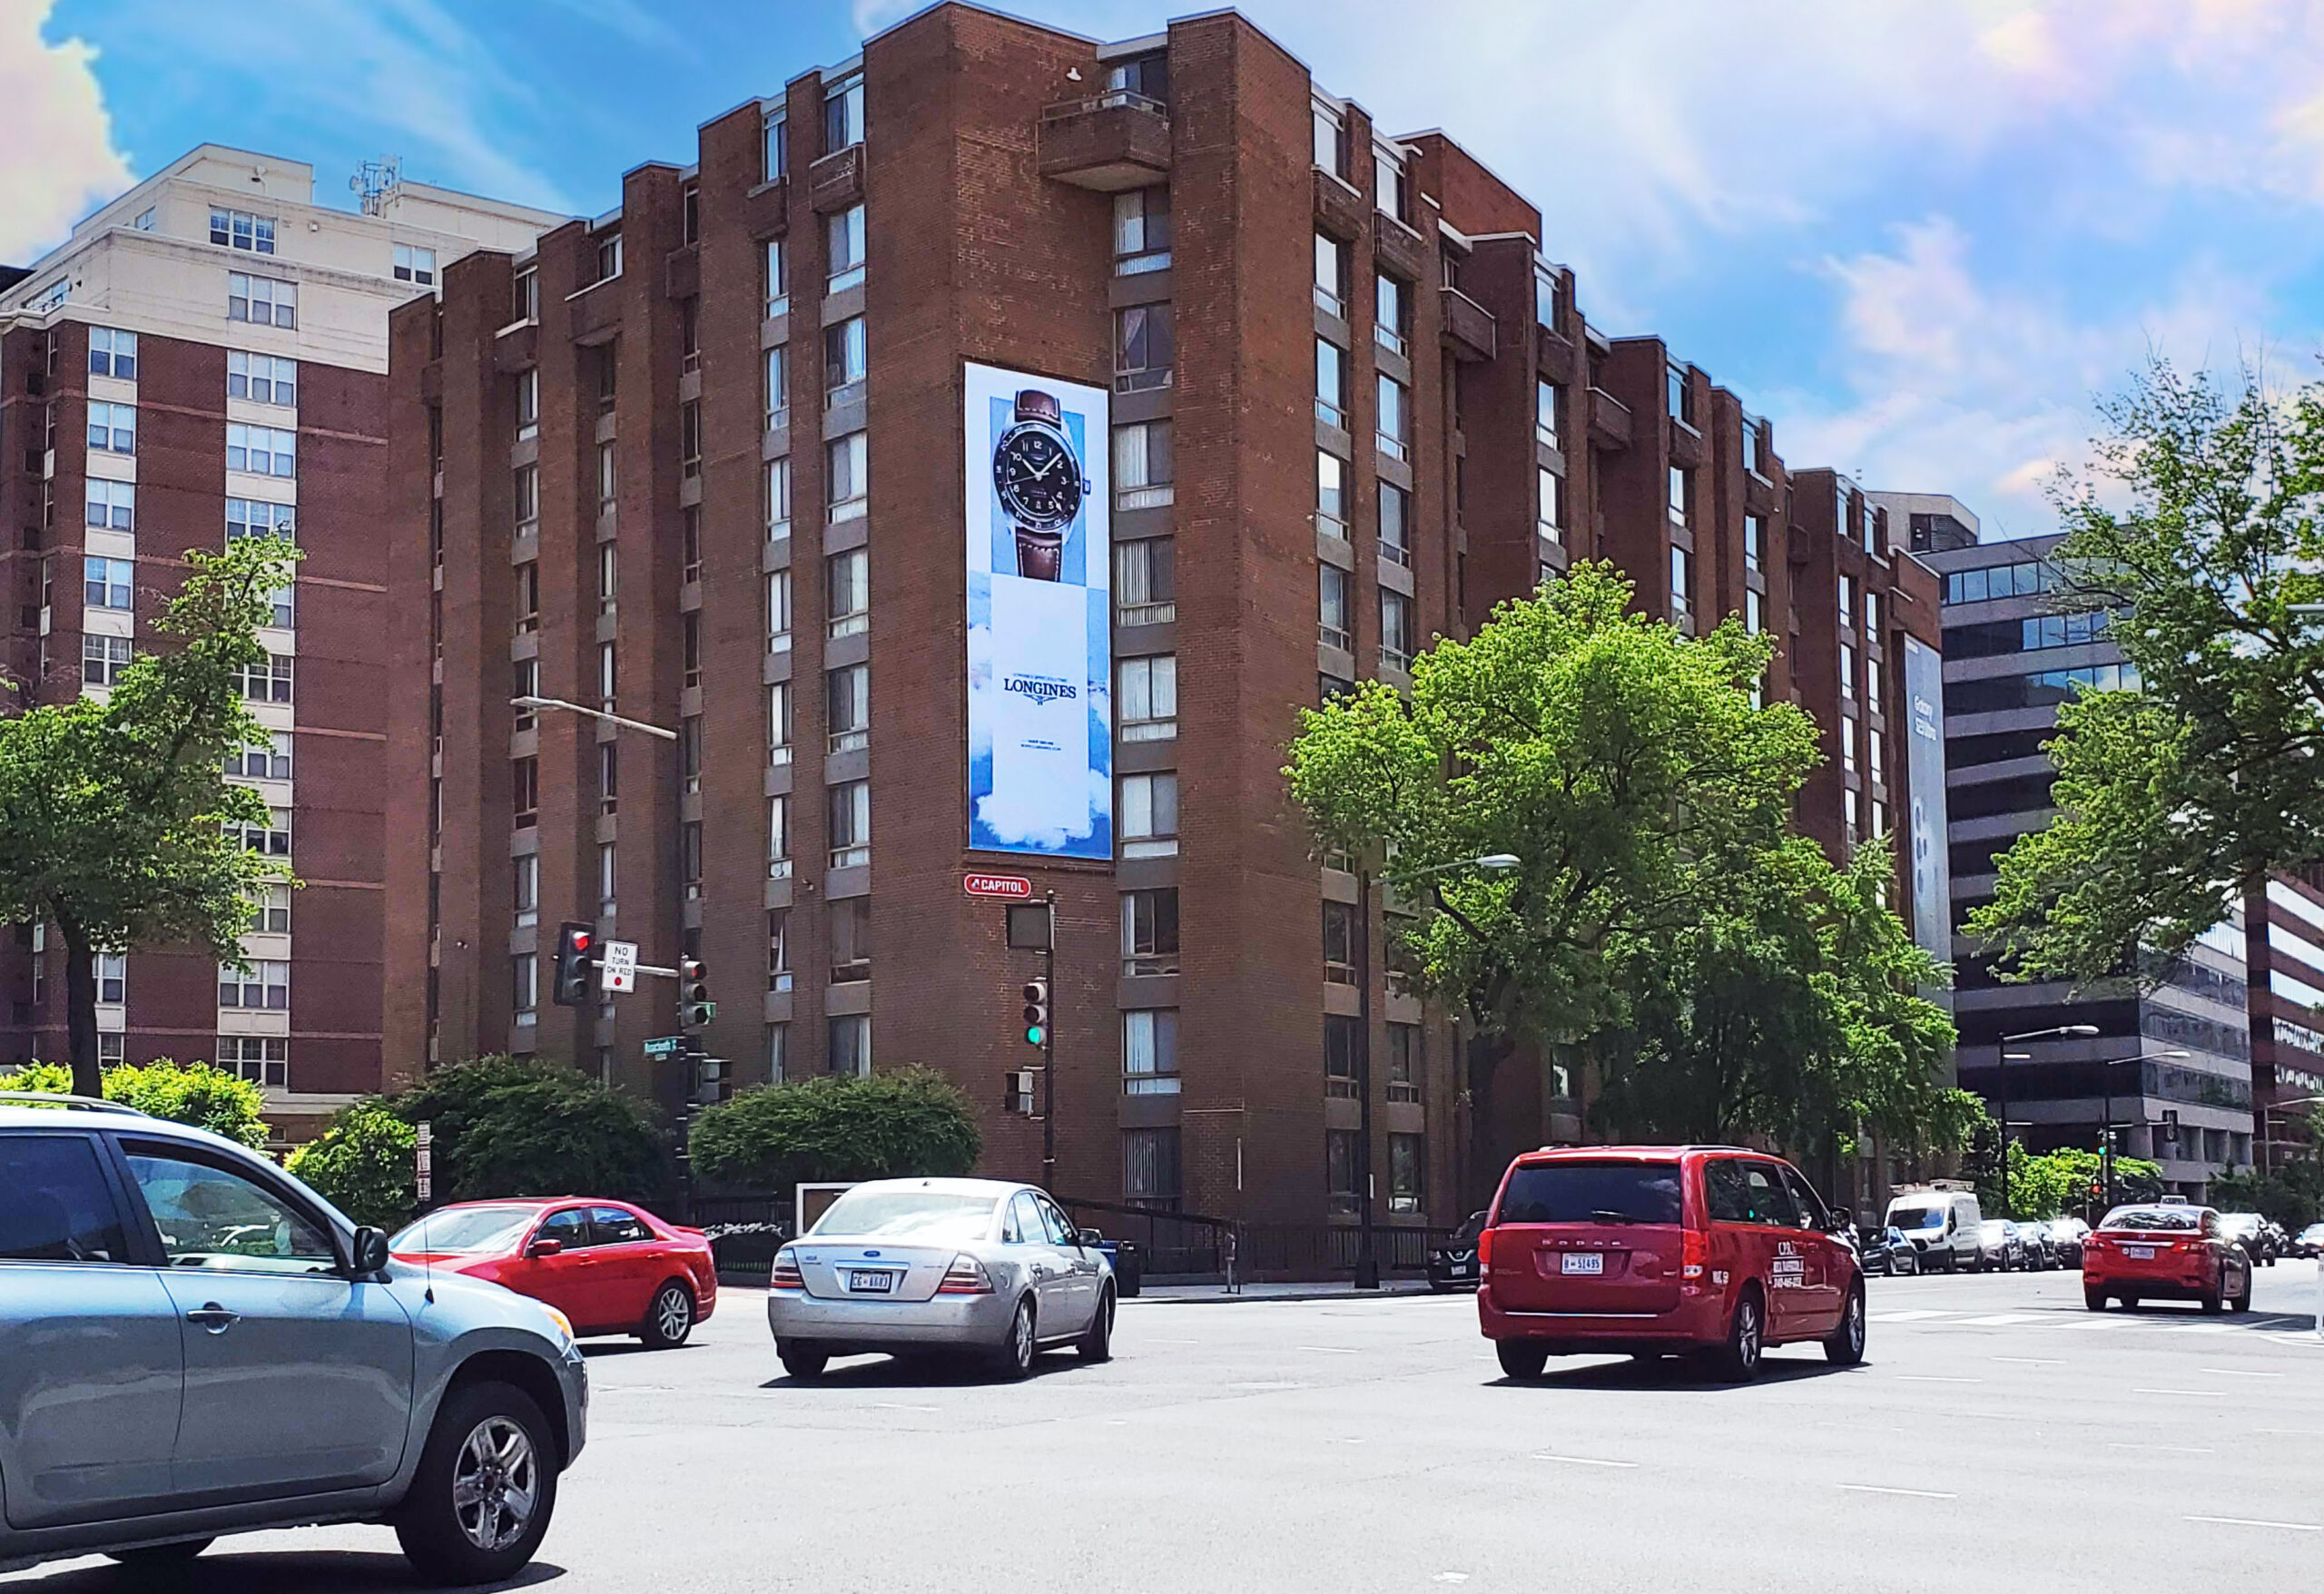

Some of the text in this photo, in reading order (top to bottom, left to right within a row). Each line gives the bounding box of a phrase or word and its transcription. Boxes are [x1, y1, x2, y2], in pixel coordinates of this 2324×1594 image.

[1034, 440, 1042, 449] 12
[1010, 451, 1022, 461] 10
[1057, 460, 1063, 469] 2
[1009, 467, 1016, 477] 9
[1060, 477, 1067, 485] 3
[1056, 491, 1063, 500] 4
[1022, 497, 1029, 505] 7
[1048, 500, 1054, 509] 5
[1003, 678, 1077, 699] LONGINES
[1914, 694, 1933, 722] Galaxy
[980, 880, 1024, 893] CAPITOL
[615, 946, 628, 957] NO
[612, 957, 630, 965] TURN
[606, 966, 632, 977] ON RED
